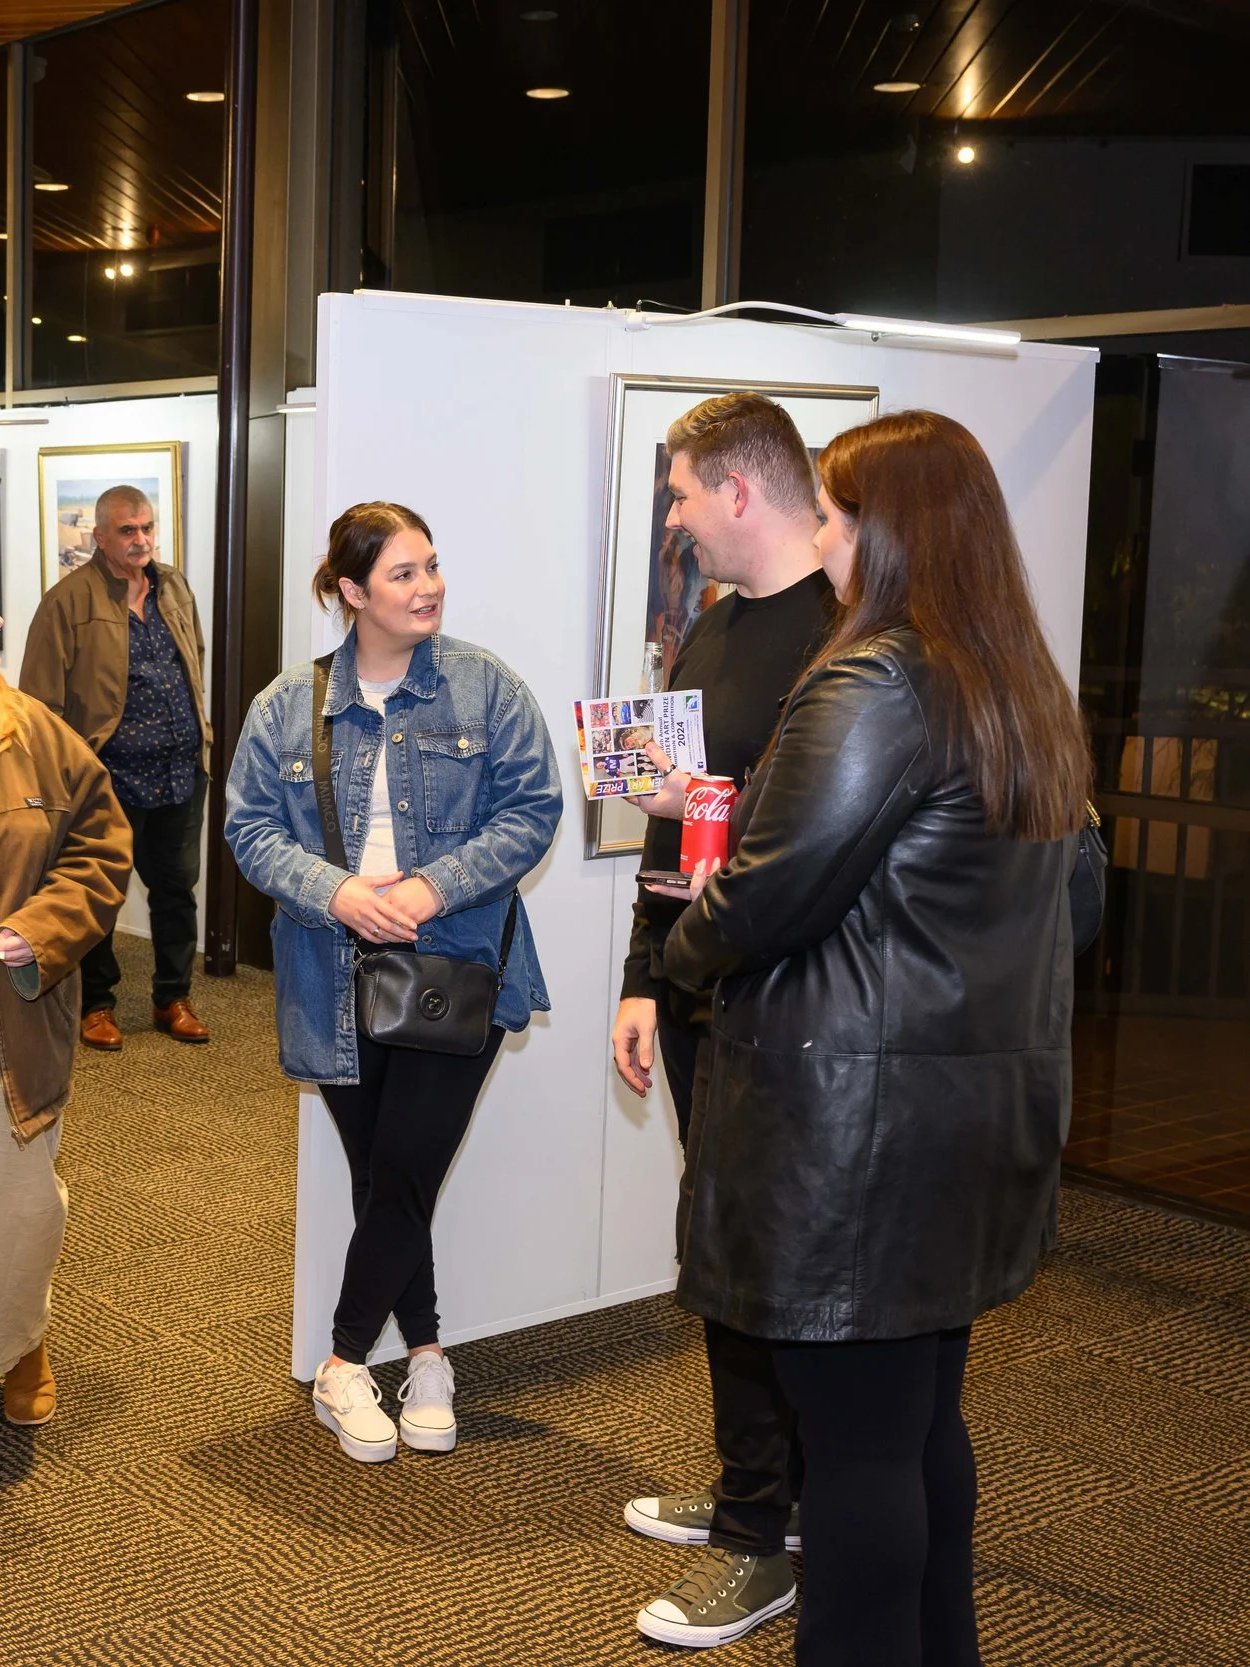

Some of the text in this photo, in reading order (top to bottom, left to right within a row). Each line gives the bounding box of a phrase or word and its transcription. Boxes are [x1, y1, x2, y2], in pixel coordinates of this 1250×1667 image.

[676, 721, 685, 746] 2024
[596, 778, 664, 793] EN ART PRIZE
[684, 786, 733, 822] Cola
